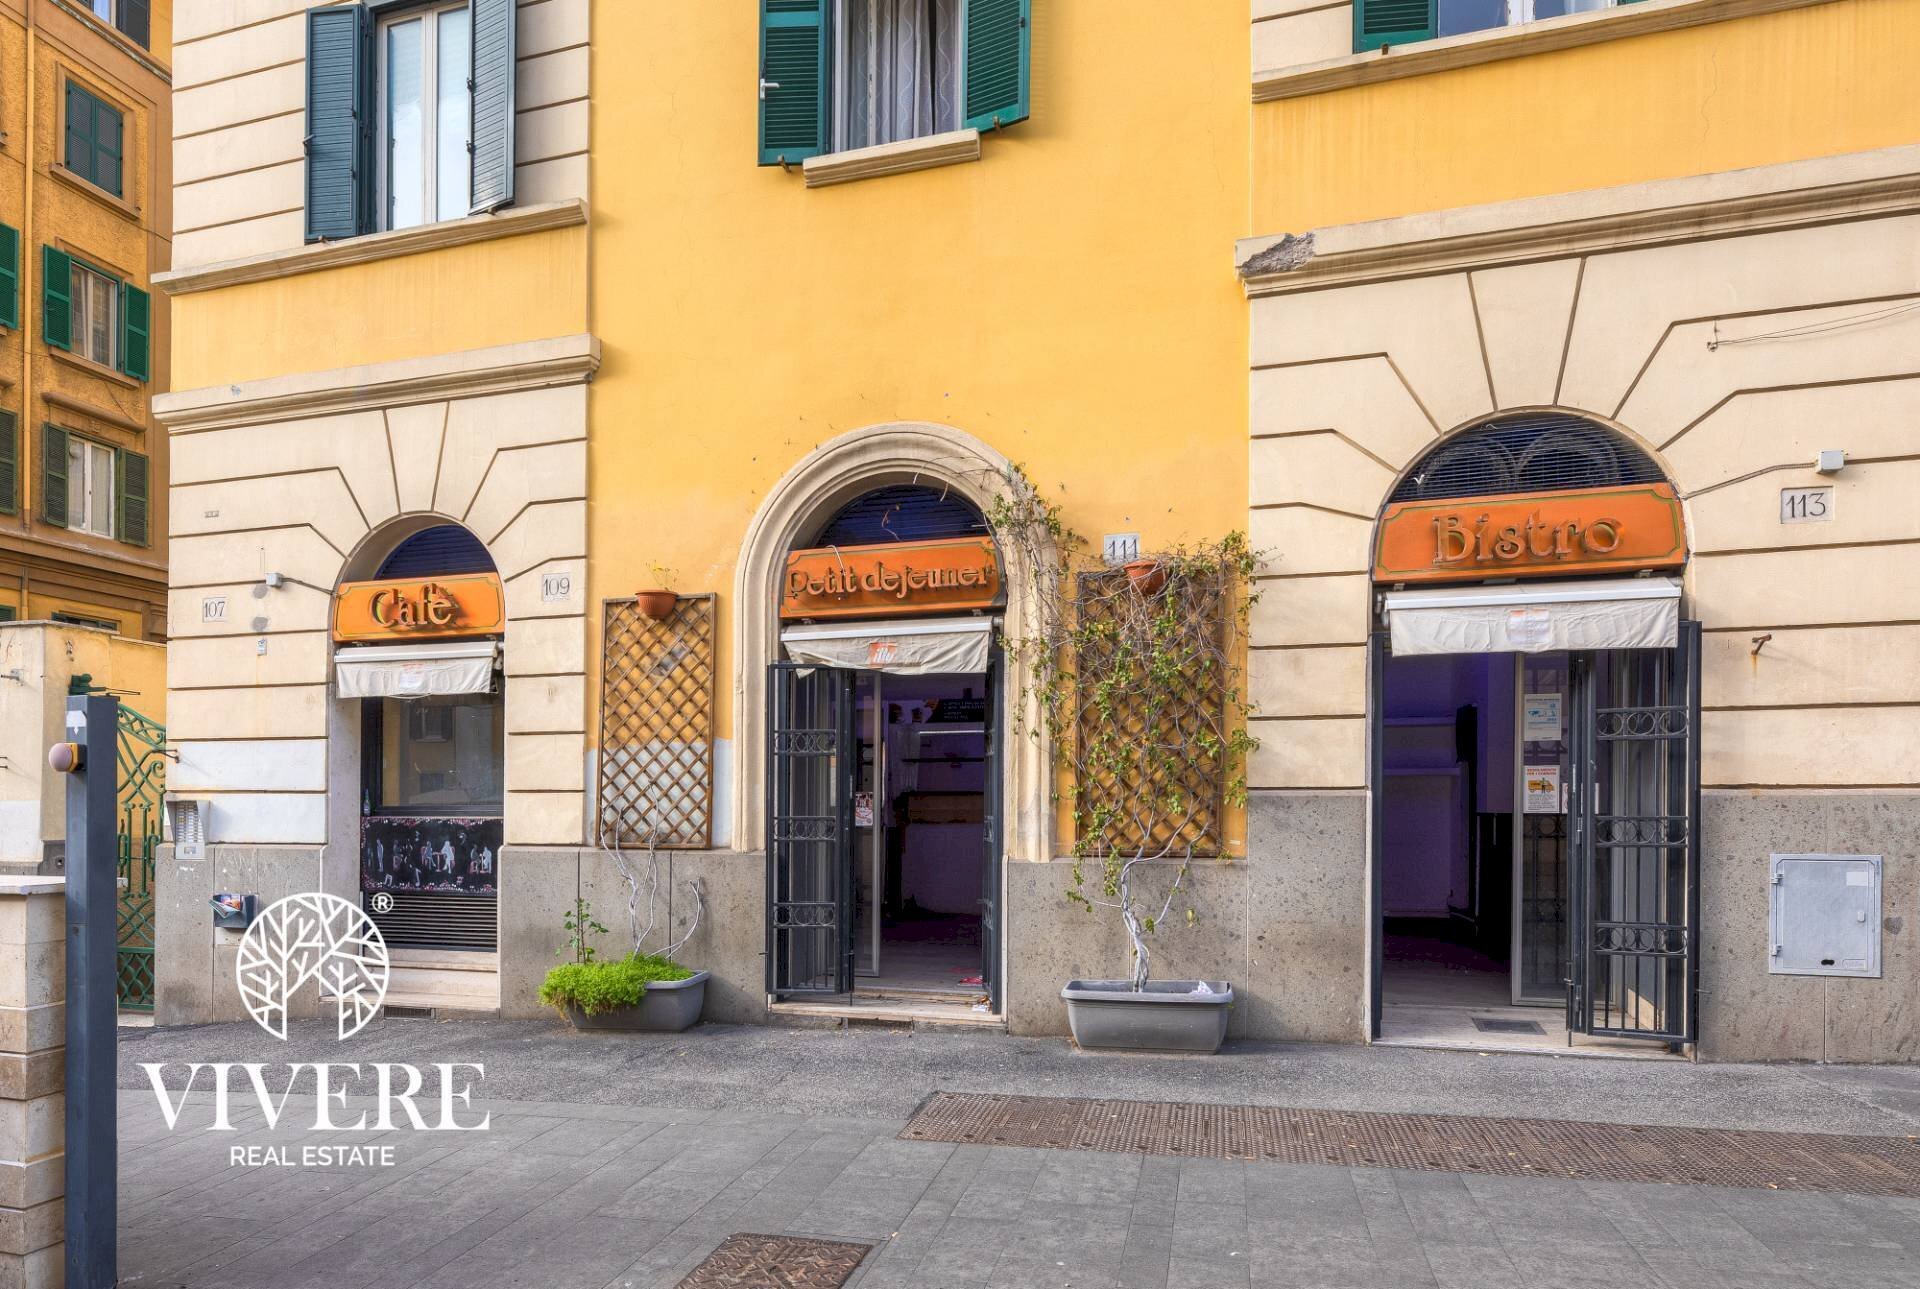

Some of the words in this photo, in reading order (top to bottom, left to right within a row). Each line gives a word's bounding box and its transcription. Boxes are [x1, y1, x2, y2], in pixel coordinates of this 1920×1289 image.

[1784, 491, 1826, 519] 113
[1432, 507, 1624, 566] Bistro
[1107, 538, 1138, 561] 111
[543, 576, 570, 597] 109
[788, 565, 858, 595] Petit
[203, 600, 226, 619] 107
